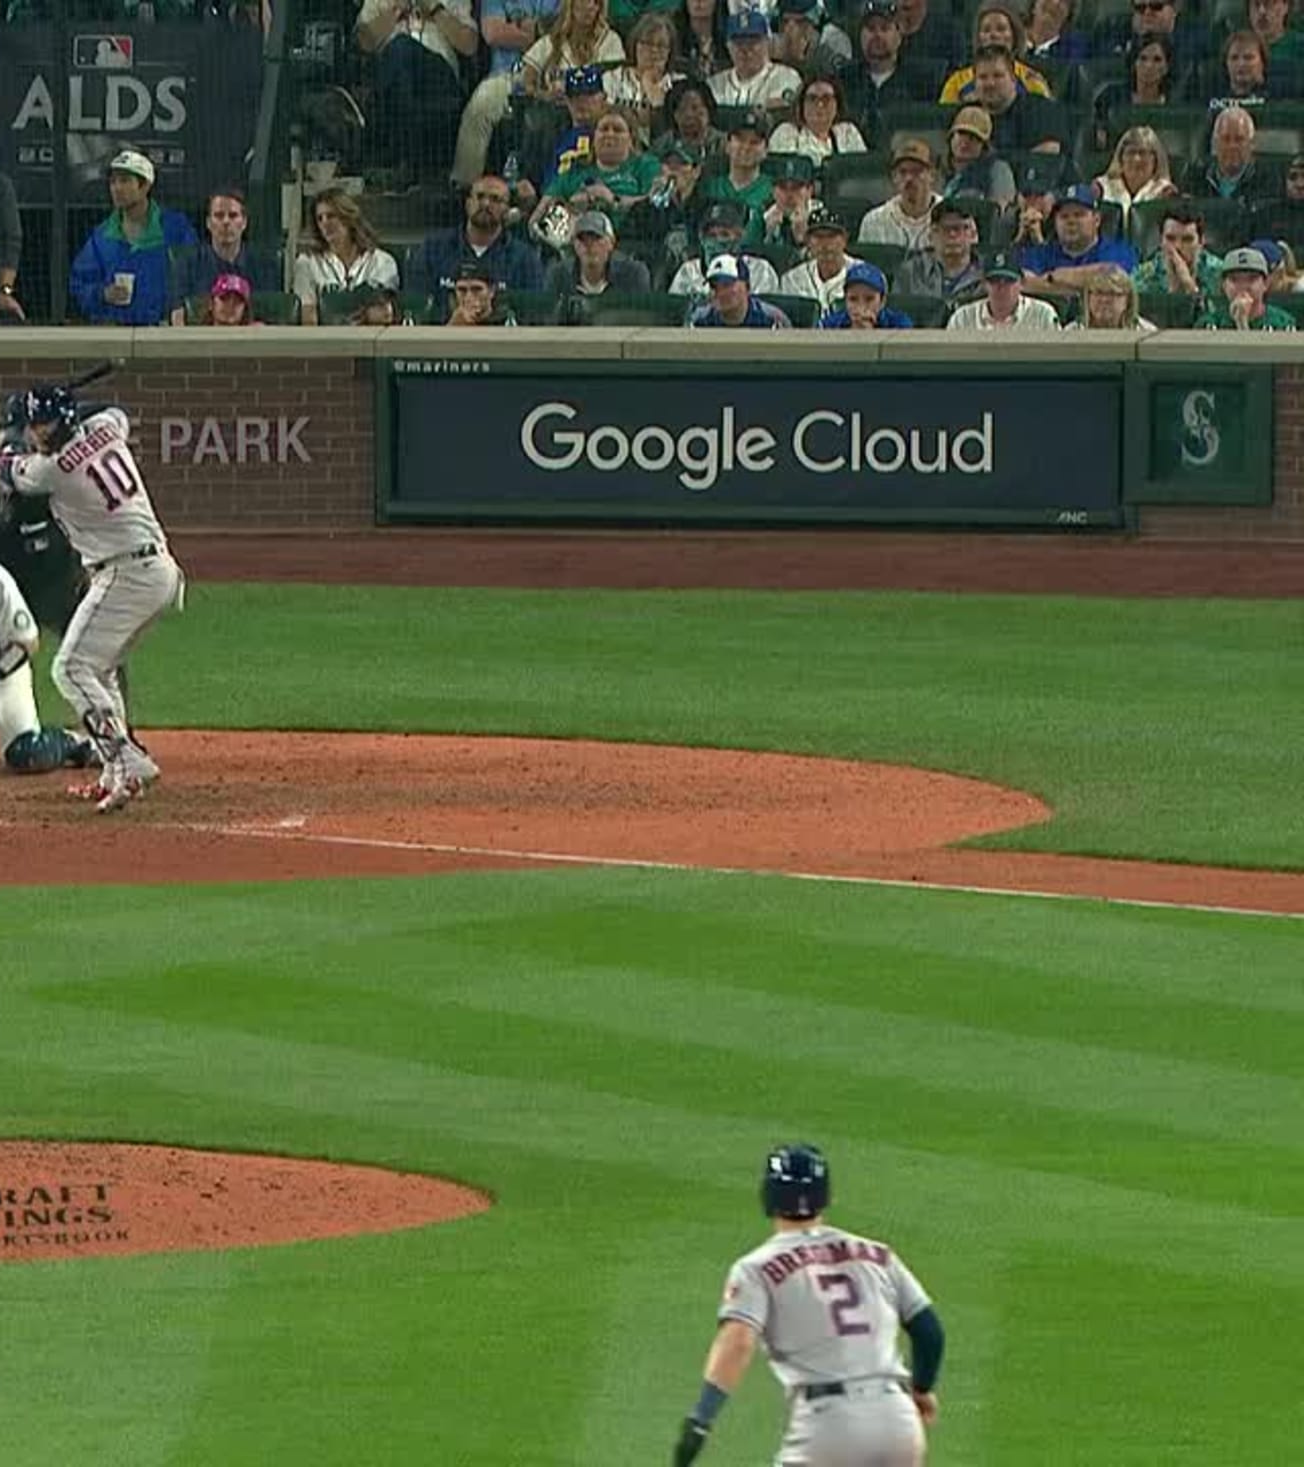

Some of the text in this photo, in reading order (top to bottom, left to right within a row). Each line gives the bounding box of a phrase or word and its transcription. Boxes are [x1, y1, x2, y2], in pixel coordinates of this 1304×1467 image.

[11, 74, 187, 131] ALDS
[160, 416, 313, 465] PARK
[520, 402, 994, 491] Google Cloud
[86, 449, 138, 512] 10
[817, 1272, 871, 1337] 2
